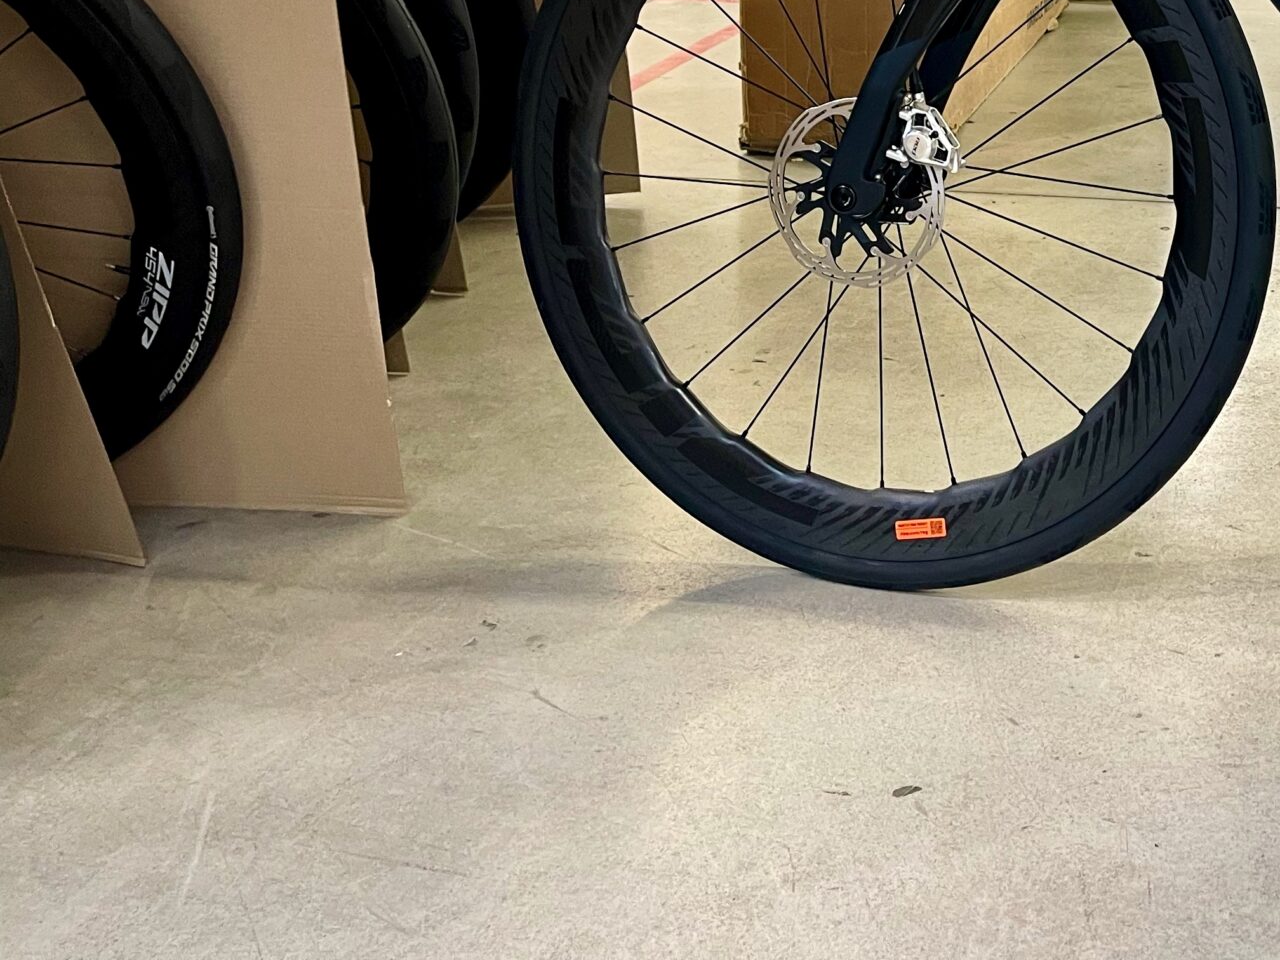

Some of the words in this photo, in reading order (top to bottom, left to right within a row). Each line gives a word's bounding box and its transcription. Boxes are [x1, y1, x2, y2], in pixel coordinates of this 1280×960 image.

[206, 242, 218, 302] GRAND
[141, 251, 175, 350] ZIPP
[197, 299, 212, 342] PRIX
[174, 338, 200, 383] 5000
